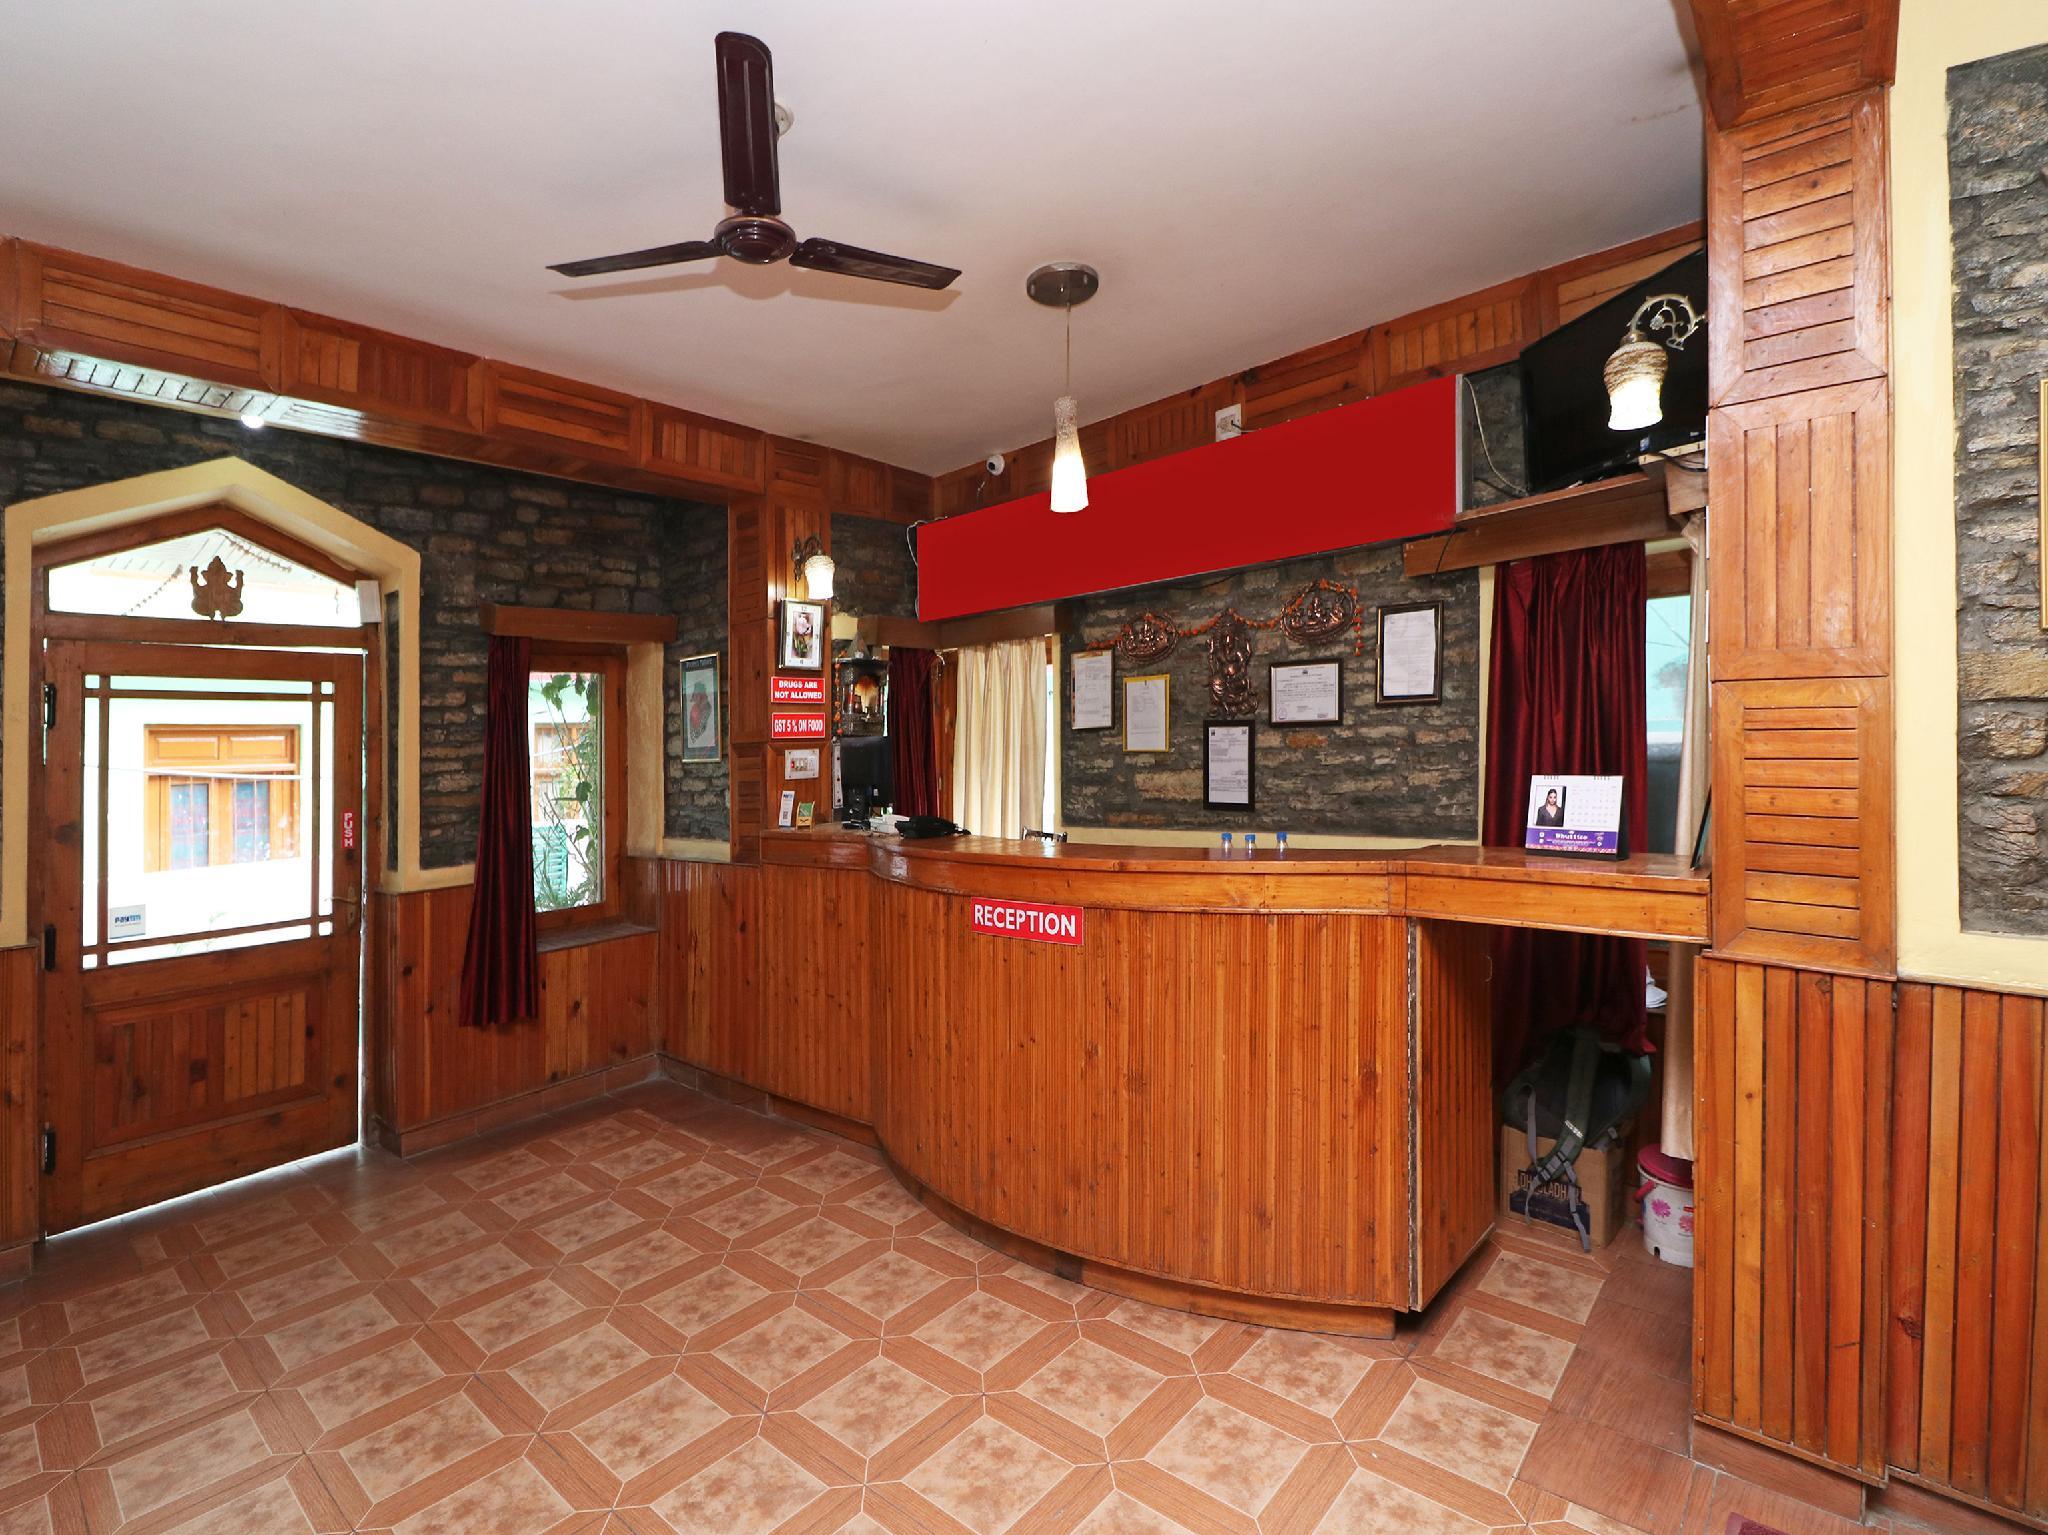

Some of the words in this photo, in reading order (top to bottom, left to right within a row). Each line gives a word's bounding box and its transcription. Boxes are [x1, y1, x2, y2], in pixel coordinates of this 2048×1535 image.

[778, 680, 803, 689] DRUGS
[804, 681, 818, 689] ARE
[774, 719, 786, 732] GST
[787, 720, 792, 732] 5
[792, 719, 798, 733] %
[798, 719, 807, 732] ON
[808, 719, 823, 732] FOOD
[343, 812, 353, 847] PUSH
[974, 904, 1076, 938] RECEPTION
